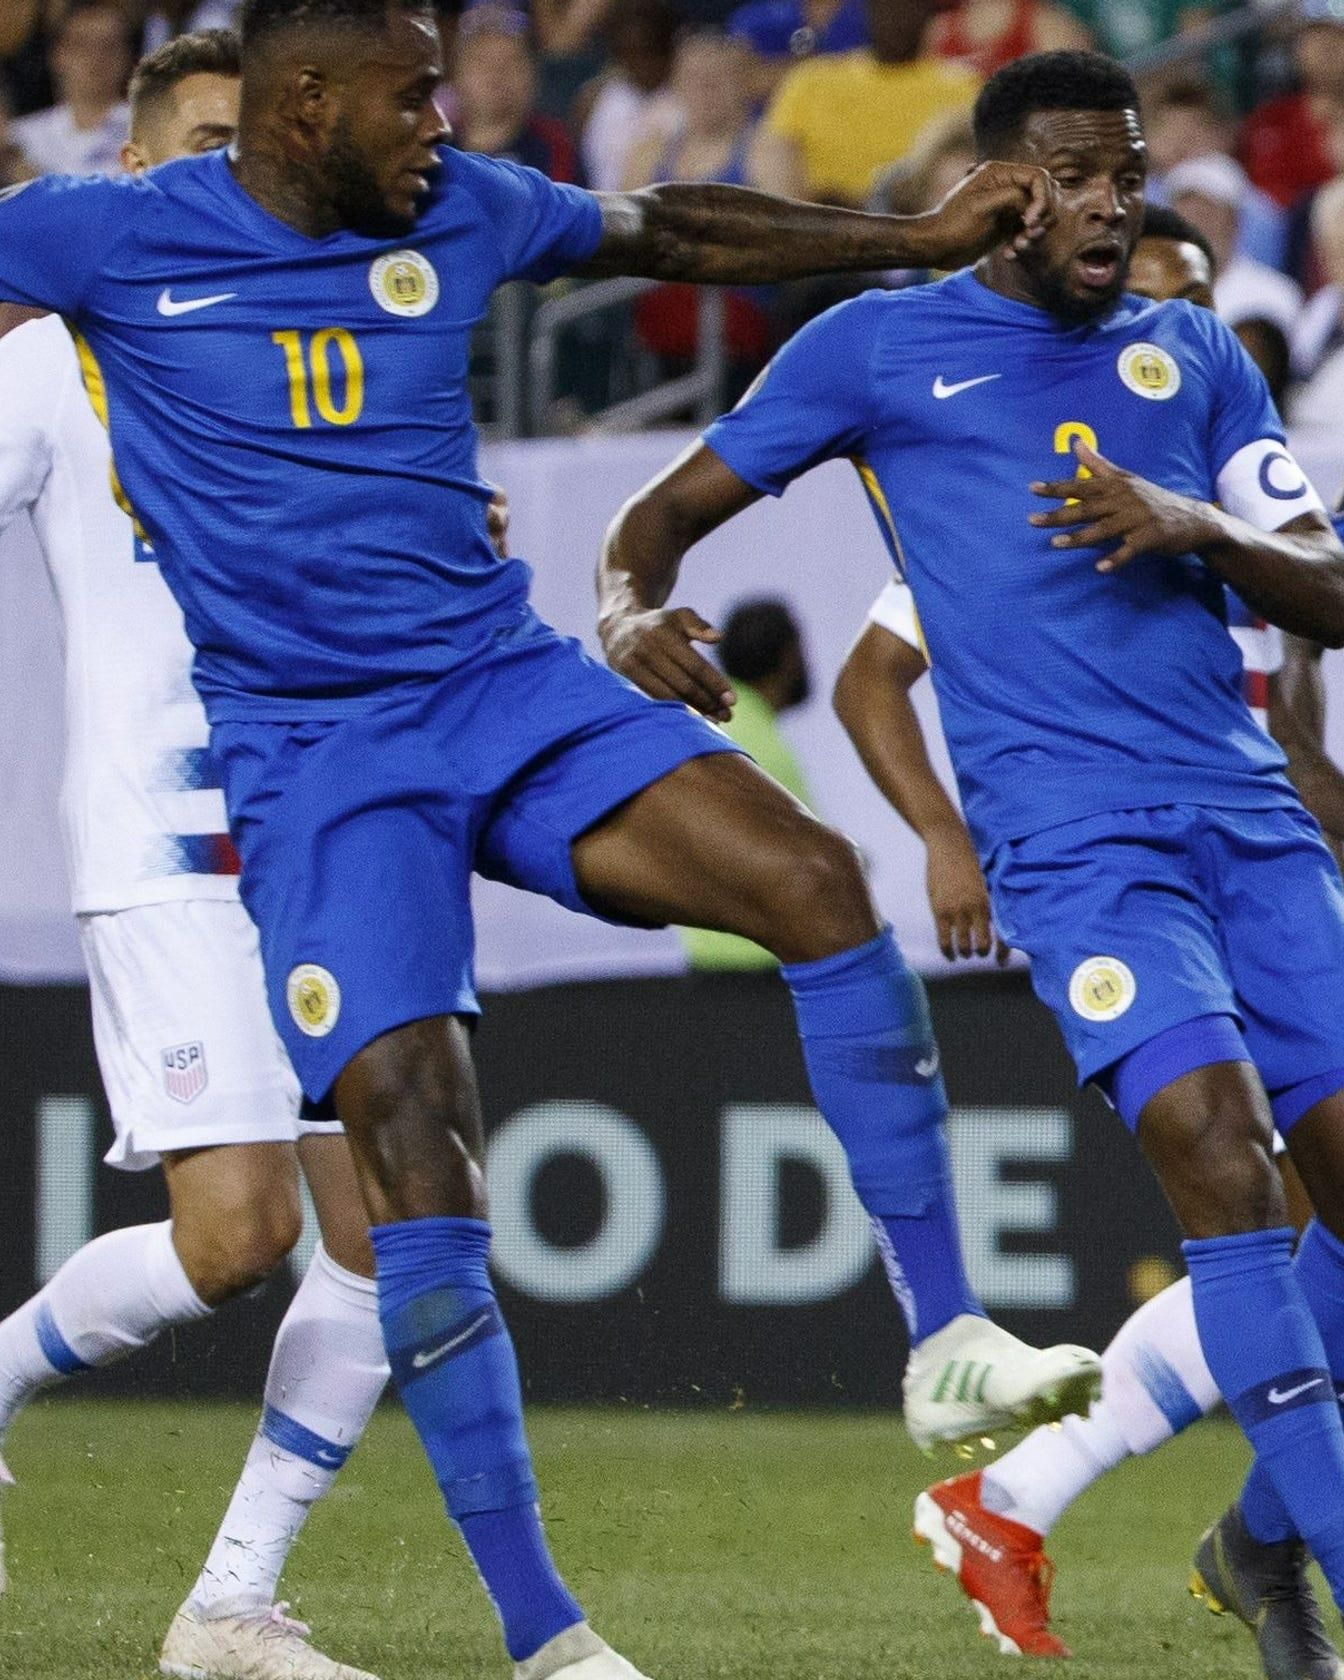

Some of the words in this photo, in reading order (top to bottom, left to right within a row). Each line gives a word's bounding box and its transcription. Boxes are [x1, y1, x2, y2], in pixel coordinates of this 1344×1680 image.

[271, 326, 365, 429] 10
[1258, 451, 1307, 500] C
[164, 1046, 199, 1070] USA
